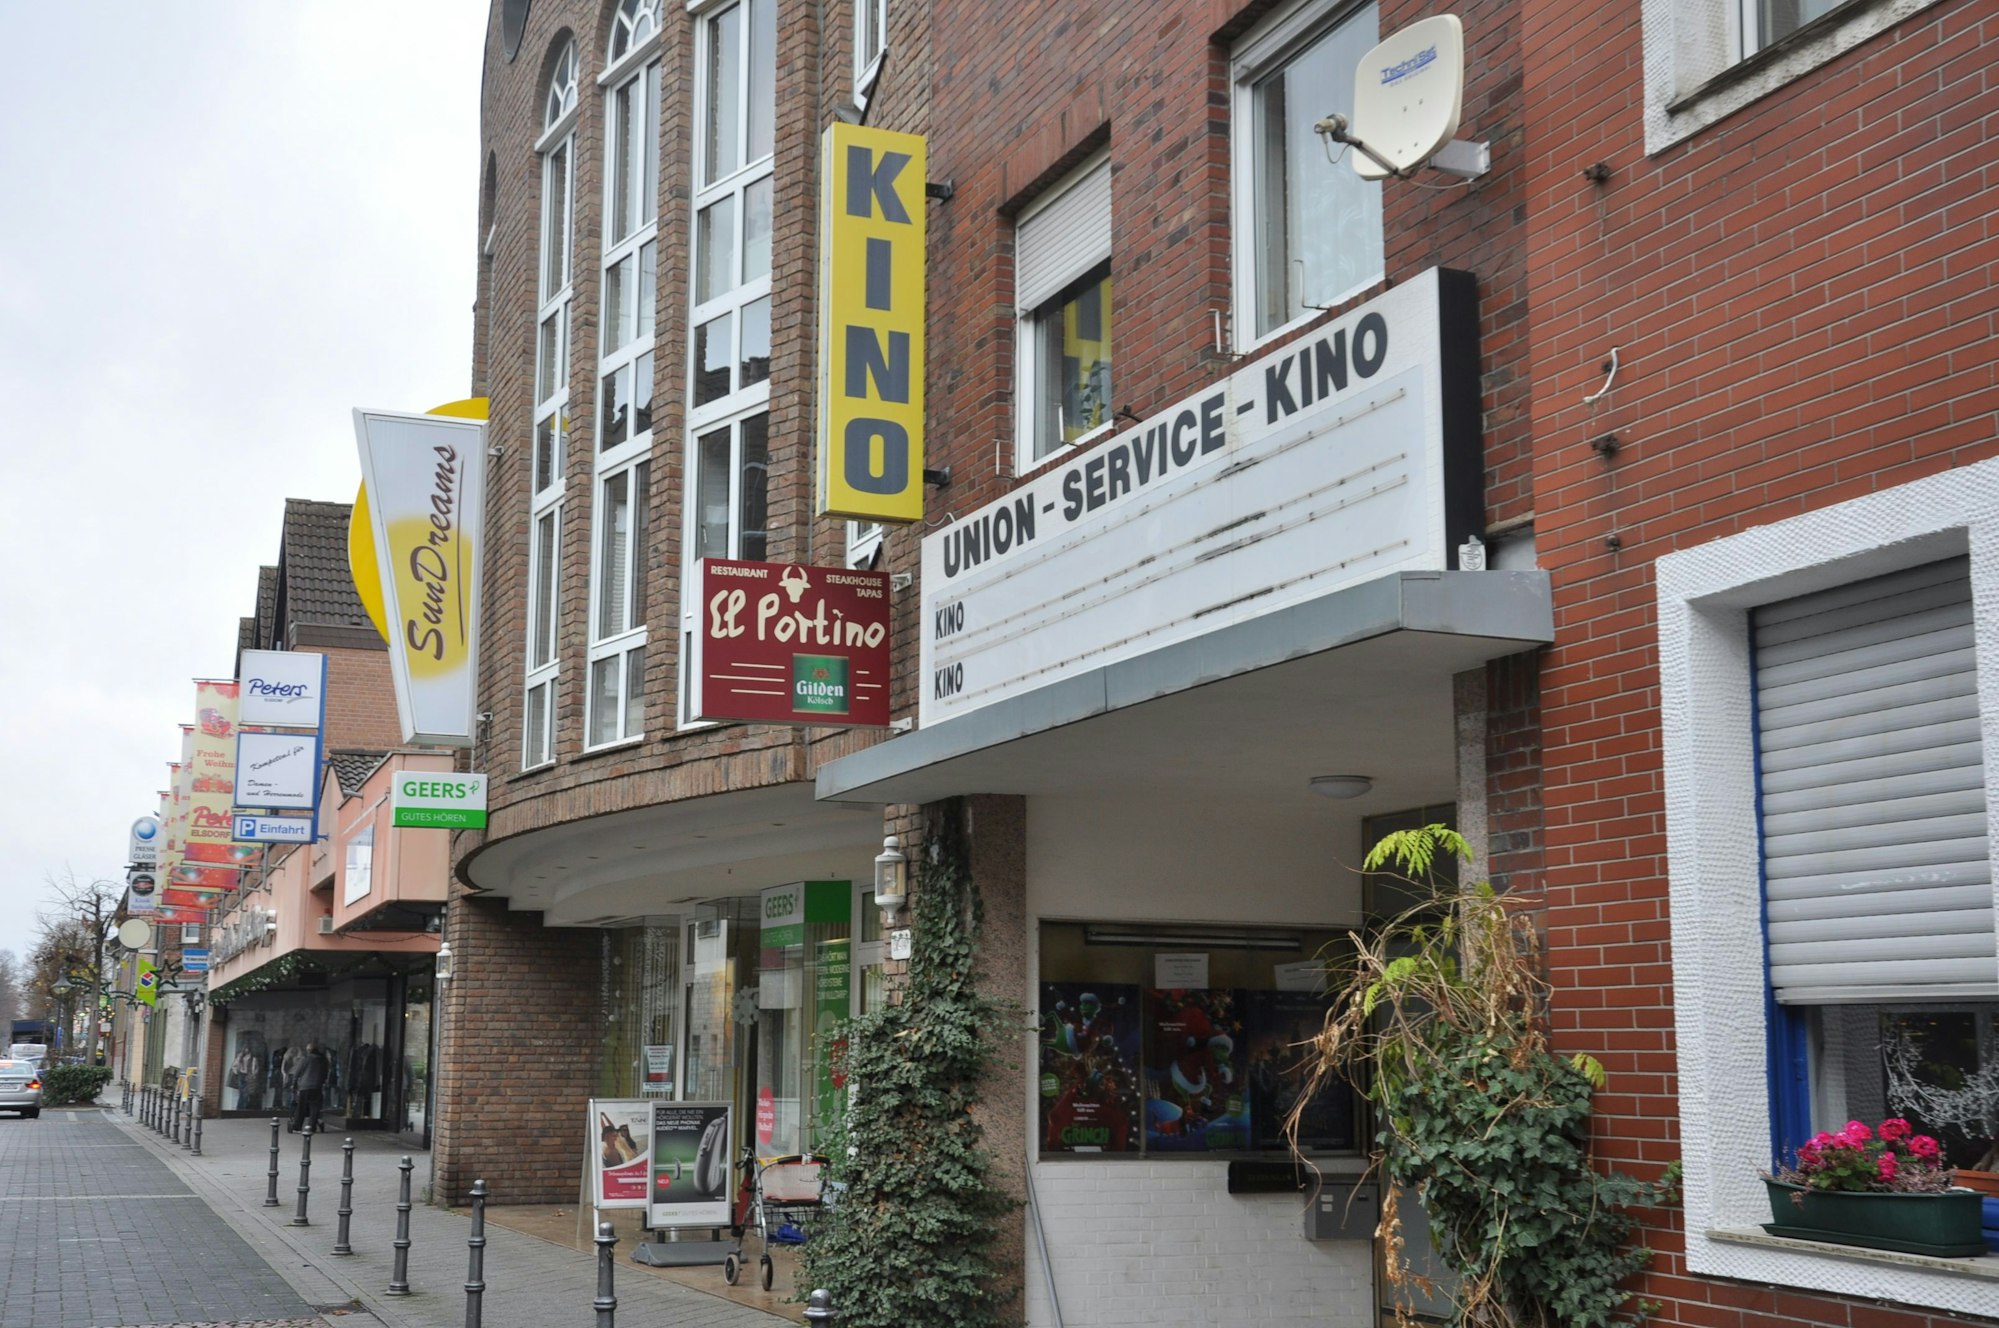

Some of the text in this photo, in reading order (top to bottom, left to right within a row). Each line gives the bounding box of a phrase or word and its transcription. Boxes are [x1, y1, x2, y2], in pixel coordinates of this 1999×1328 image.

[844, 144, 913, 495] KINO
[407, 444, 457, 661] SunDreams
[711, 565, 883, 587] RESTAURANT STEAKHOUSE
[856, 587, 883, 598] TAPAS
[710, 589, 886, 649] El Portino
[935, 601, 964, 640] KINO
[248, 678, 308, 697] Peters
[796, 680, 844, 697] Gilden
[934, 662, 963, 700] KINO
[807, 695, 834, 705] Kölsch
[196, 750, 225, 759] Frohe
[263, 790, 304, 798] Herrenmode
[403, 781, 466, 798] GEERS
[401, 812, 466, 823] GUTES HÖREN
[191, 830, 231, 839] ELSDORF
[241, 820, 305, 836] P Einfahrt
[766, 893, 794, 919] GEERS
[1062, 1126, 1110, 1145] GRINCH
